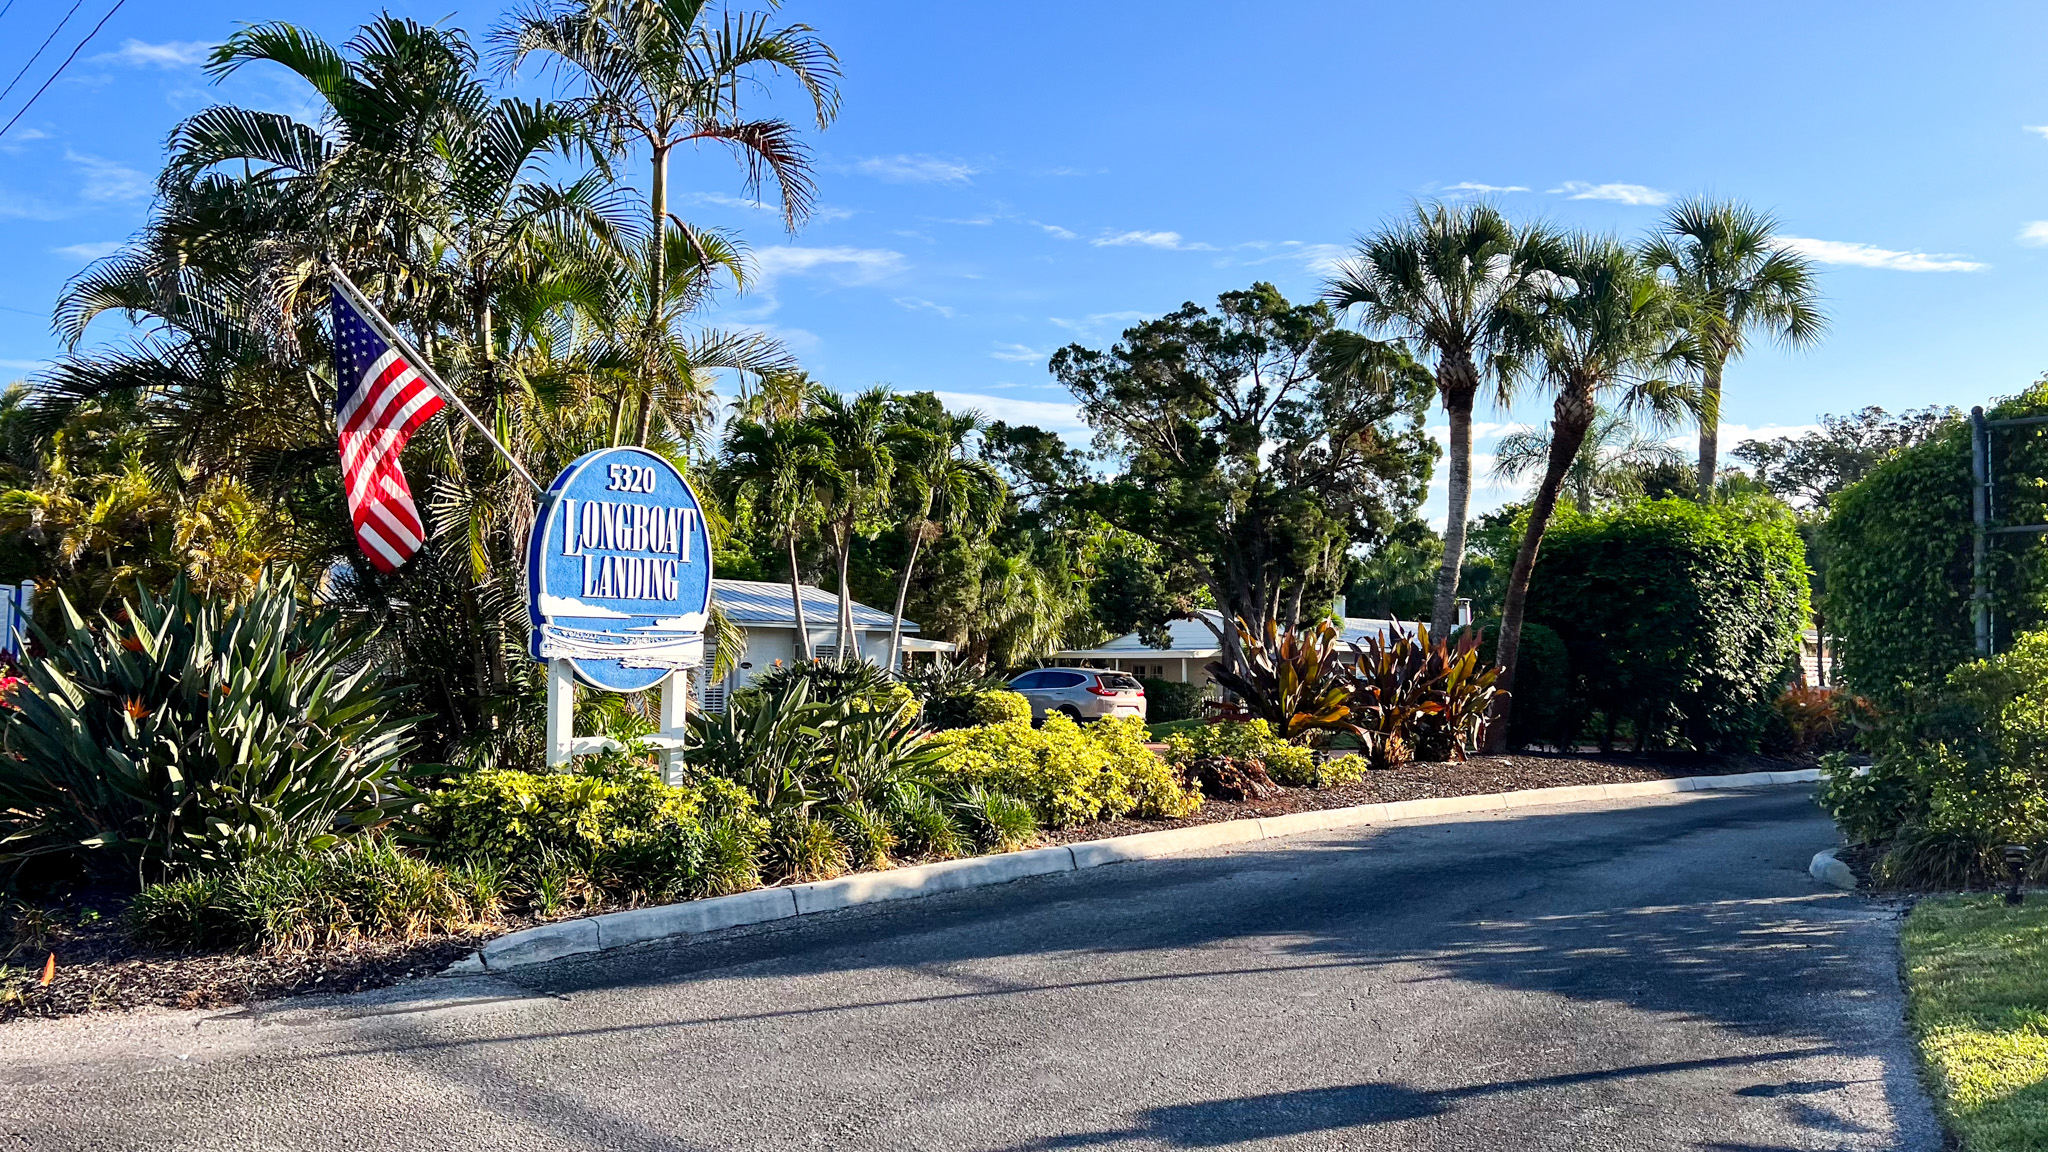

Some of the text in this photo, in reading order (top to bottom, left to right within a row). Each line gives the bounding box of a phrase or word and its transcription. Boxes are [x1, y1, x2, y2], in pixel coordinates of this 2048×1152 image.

[609, 464, 656, 493] 5320
[562, 499, 697, 563] LONGBOAT
[583, 554, 679, 600] LANDING
